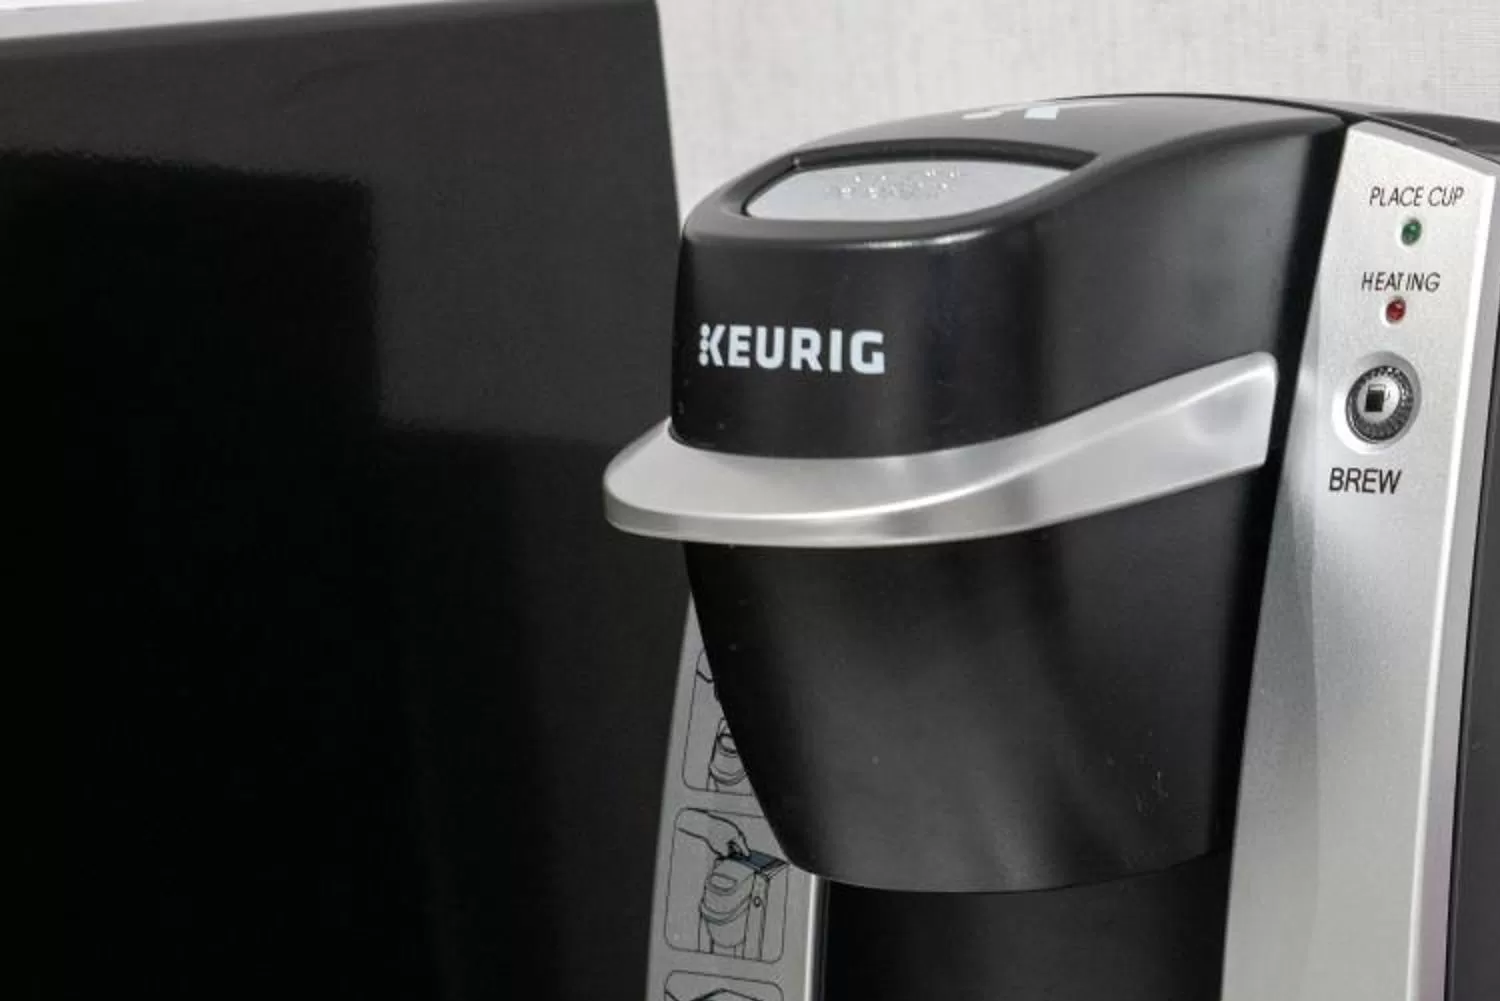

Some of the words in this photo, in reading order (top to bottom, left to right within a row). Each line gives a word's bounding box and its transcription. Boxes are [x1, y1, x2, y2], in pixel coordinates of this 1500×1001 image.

[1369, 186, 1423, 207] PLACE
[1427, 187, 1465, 207] CUP
[1361, 271, 1441, 293] HEATING
[698, 323, 885, 374] KEURIG
[1328, 467, 1402, 494] BREW
